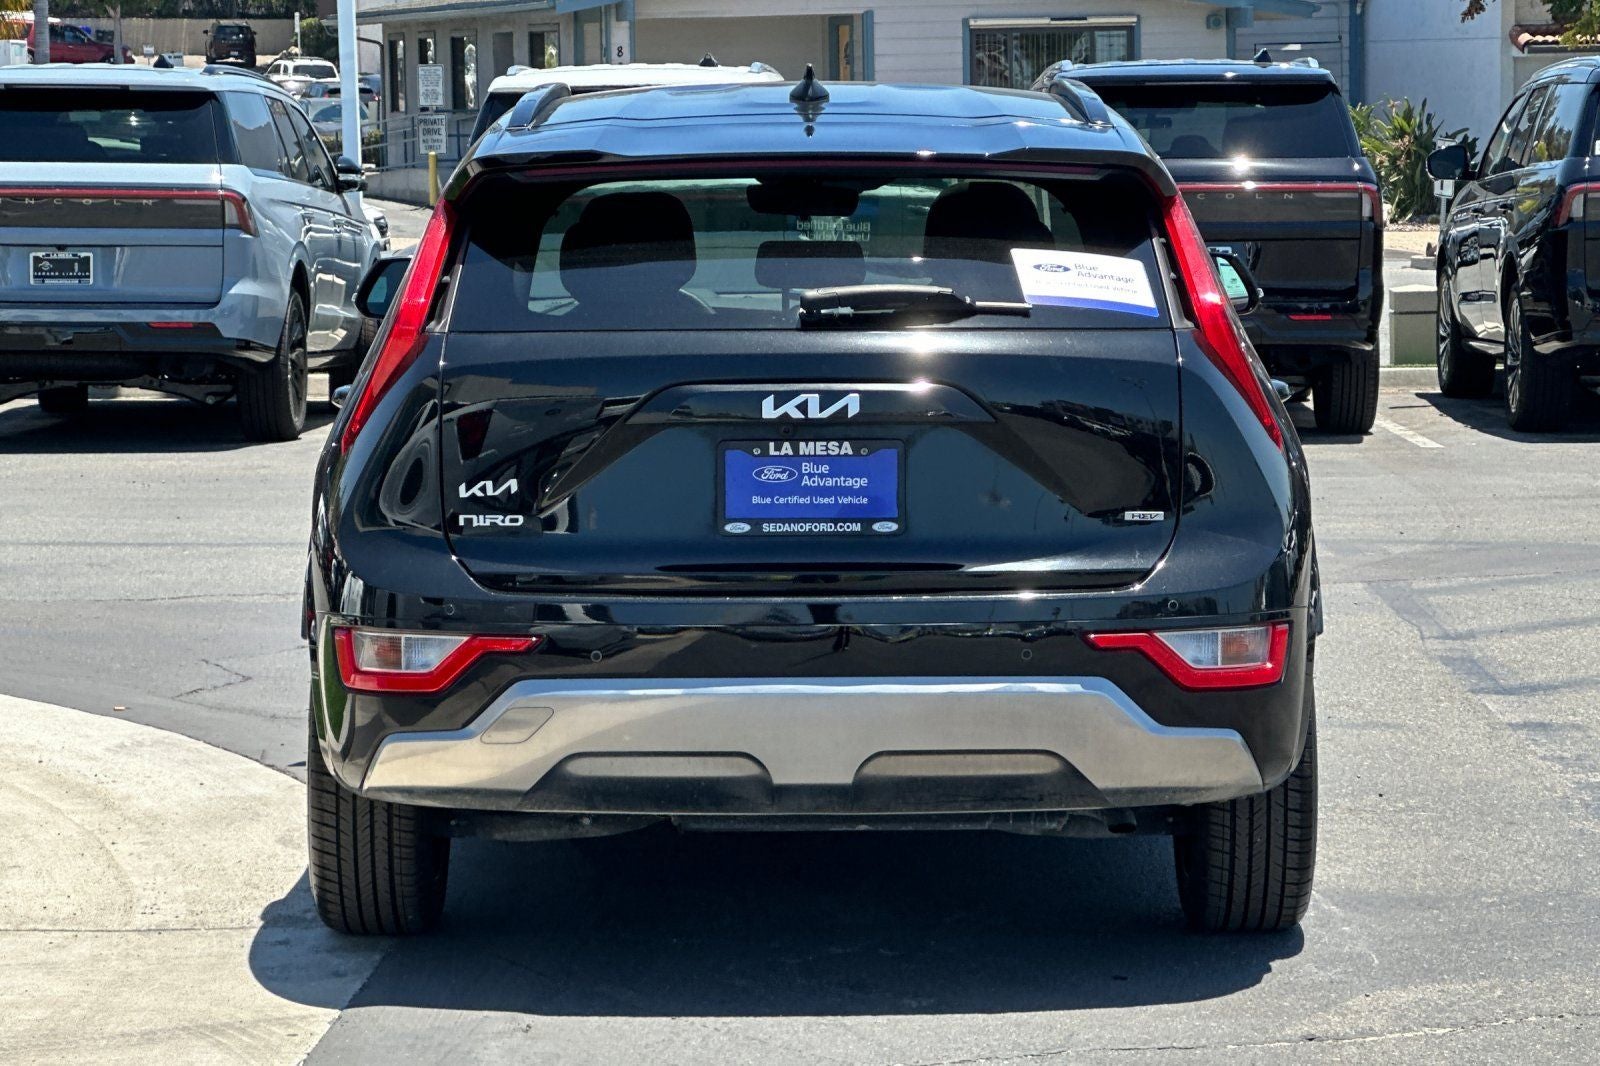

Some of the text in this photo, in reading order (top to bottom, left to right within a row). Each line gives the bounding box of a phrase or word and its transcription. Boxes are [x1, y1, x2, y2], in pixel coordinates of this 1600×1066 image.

[617, 45, 623, 57] 8
[419, 118, 444, 126] PRIVATE
[422, 128, 442, 136] DRIVE
[1074, 263, 1099, 271] Blue
[1077, 271, 1135, 284] Advantage
[761, 393, 860, 419] KIA
[768, 441, 854, 456] LA MESA
[760, 467, 791, 481] Ford
[801, 462, 829, 474] Blue
[801, 475, 868, 488] Advantage
[458, 478, 518, 498] KIA
[752, 495, 868, 504] Blue Certified Used Vehicle
[458, 514, 524, 527] NIRO
[1130, 512, 1160, 520] HEV
[762, 522, 861, 532] SEDANOFORD.COM
